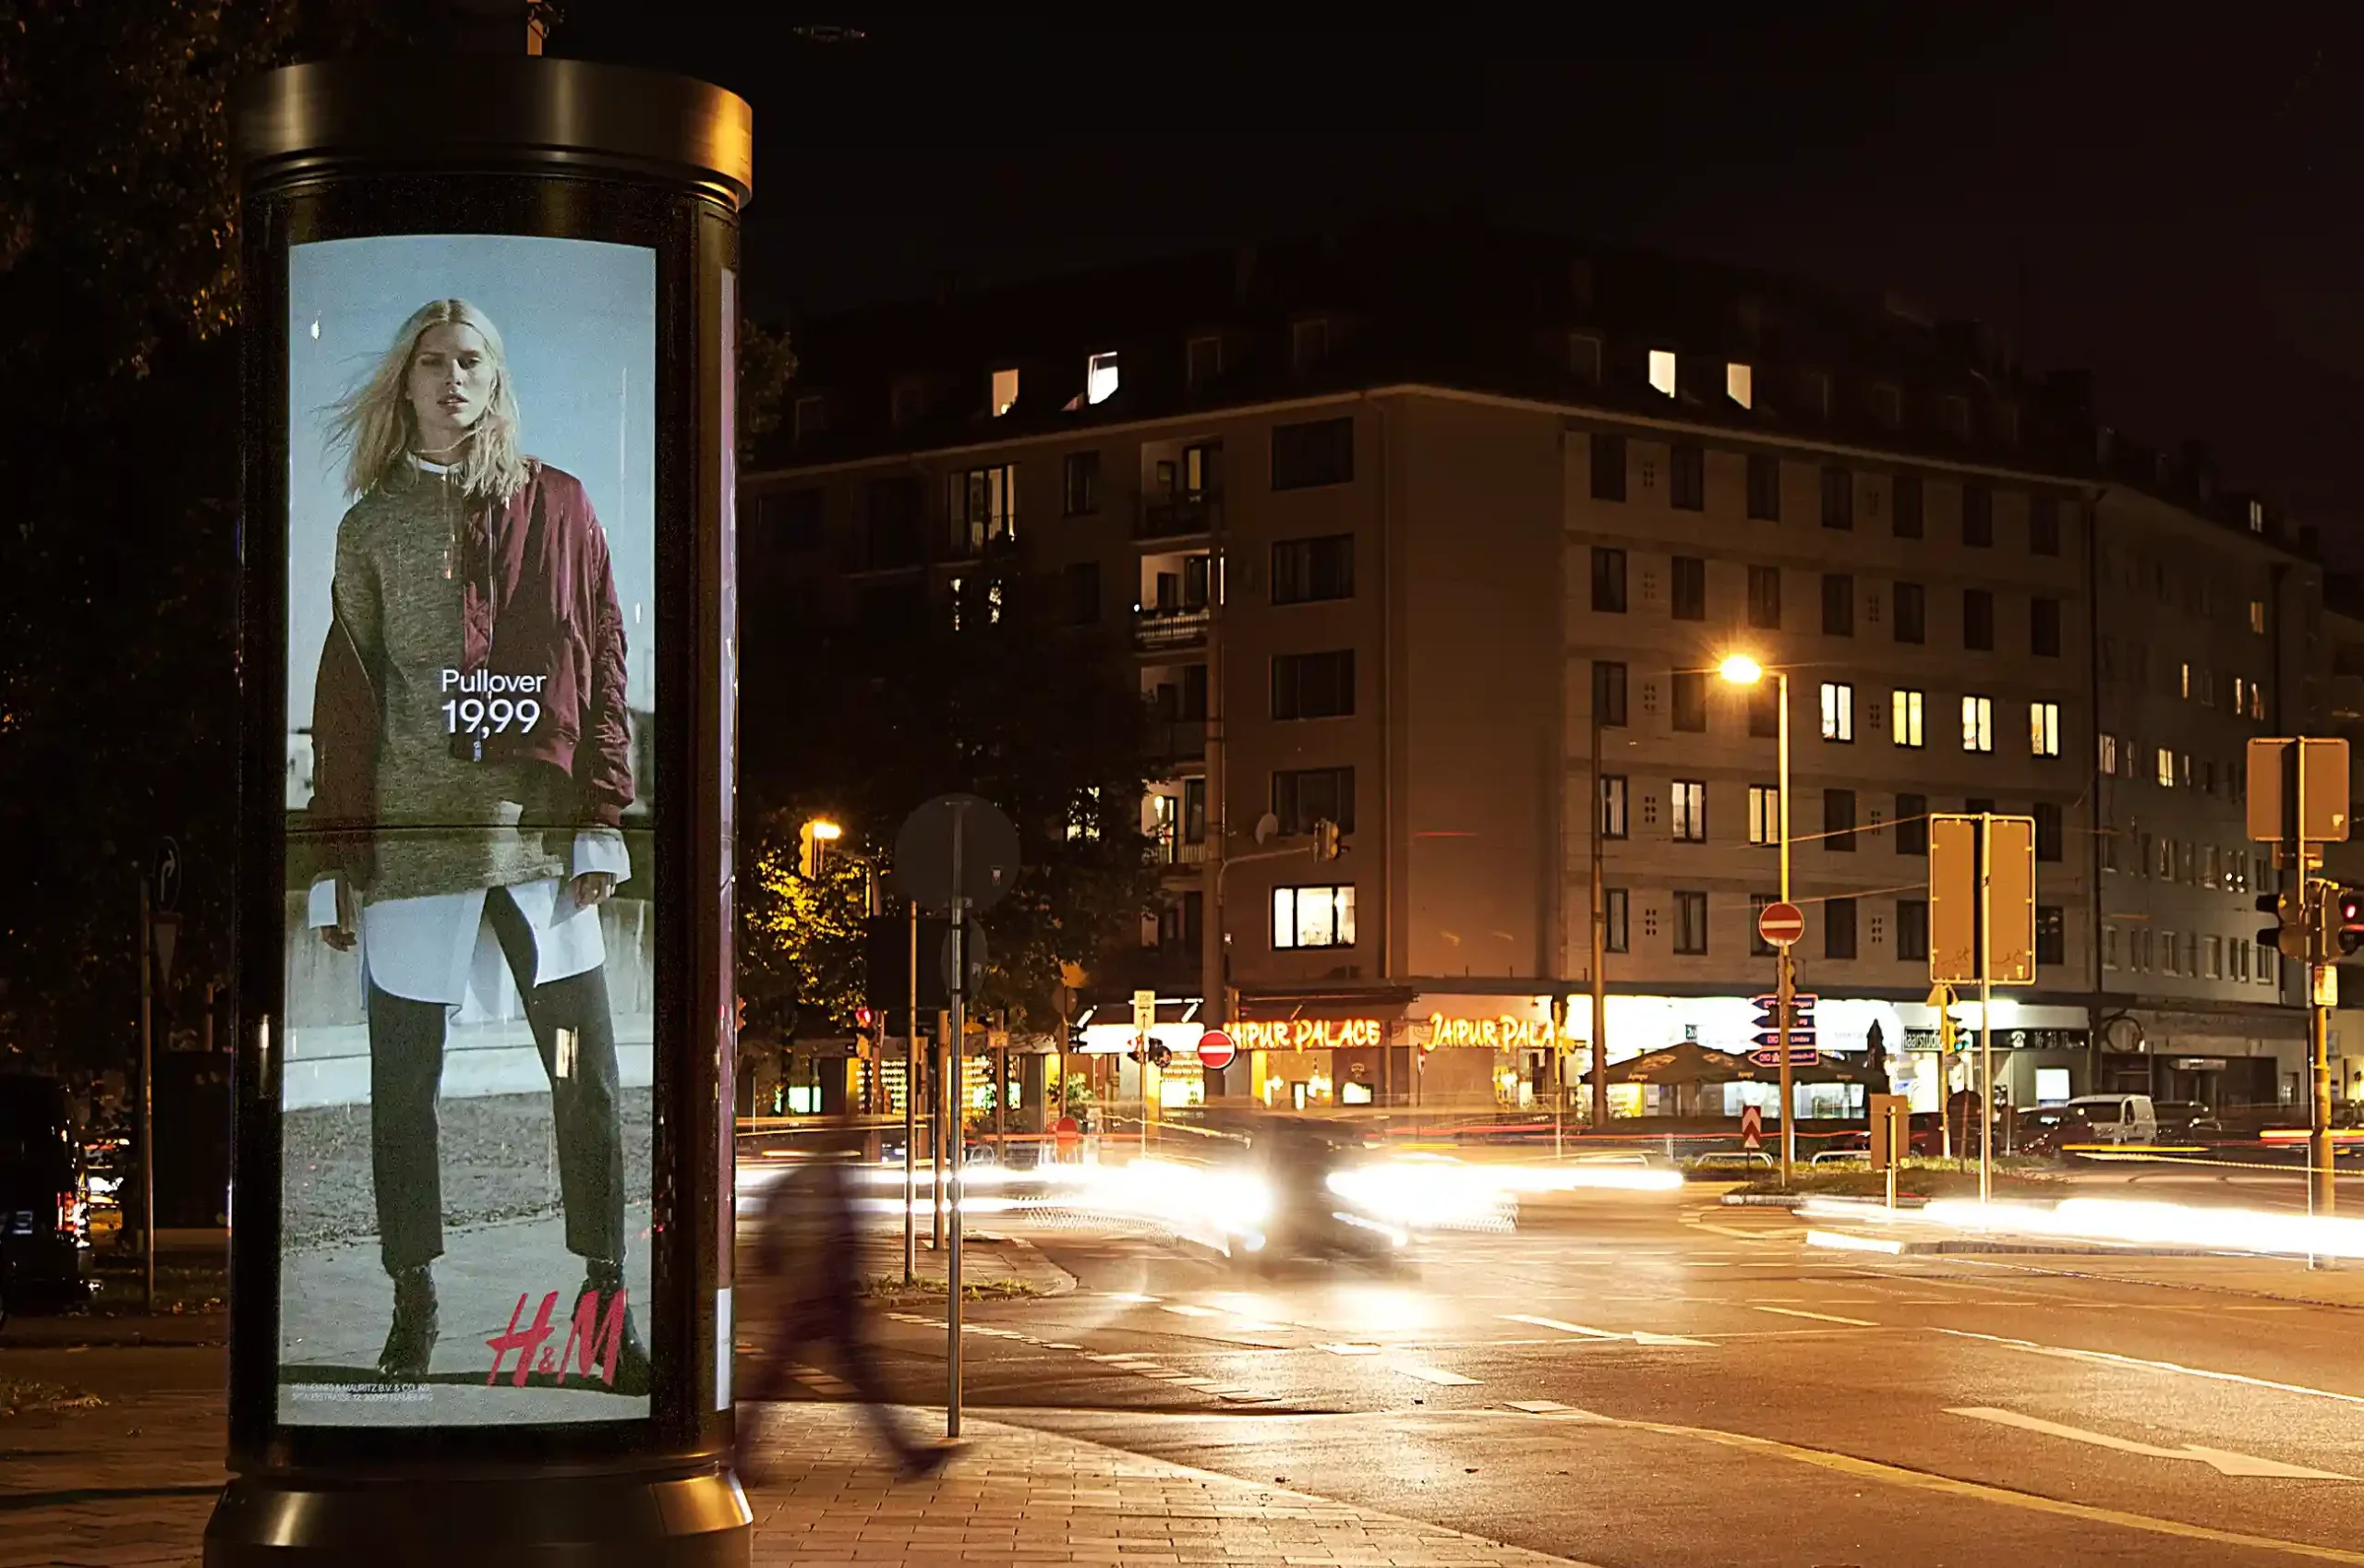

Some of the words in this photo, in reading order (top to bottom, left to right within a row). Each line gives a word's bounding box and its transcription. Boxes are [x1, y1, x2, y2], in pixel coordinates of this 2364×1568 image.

[441, 669, 547, 693] Pullover
[441, 698, 541, 739] 19,99
[1293, 1019, 1381, 1055] PALACE
[1423, 1011, 1499, 1052] JAIPUR
[1500, 1014, 1566, 1054] PALA
[485, 1288, 629, 1388] H&M
